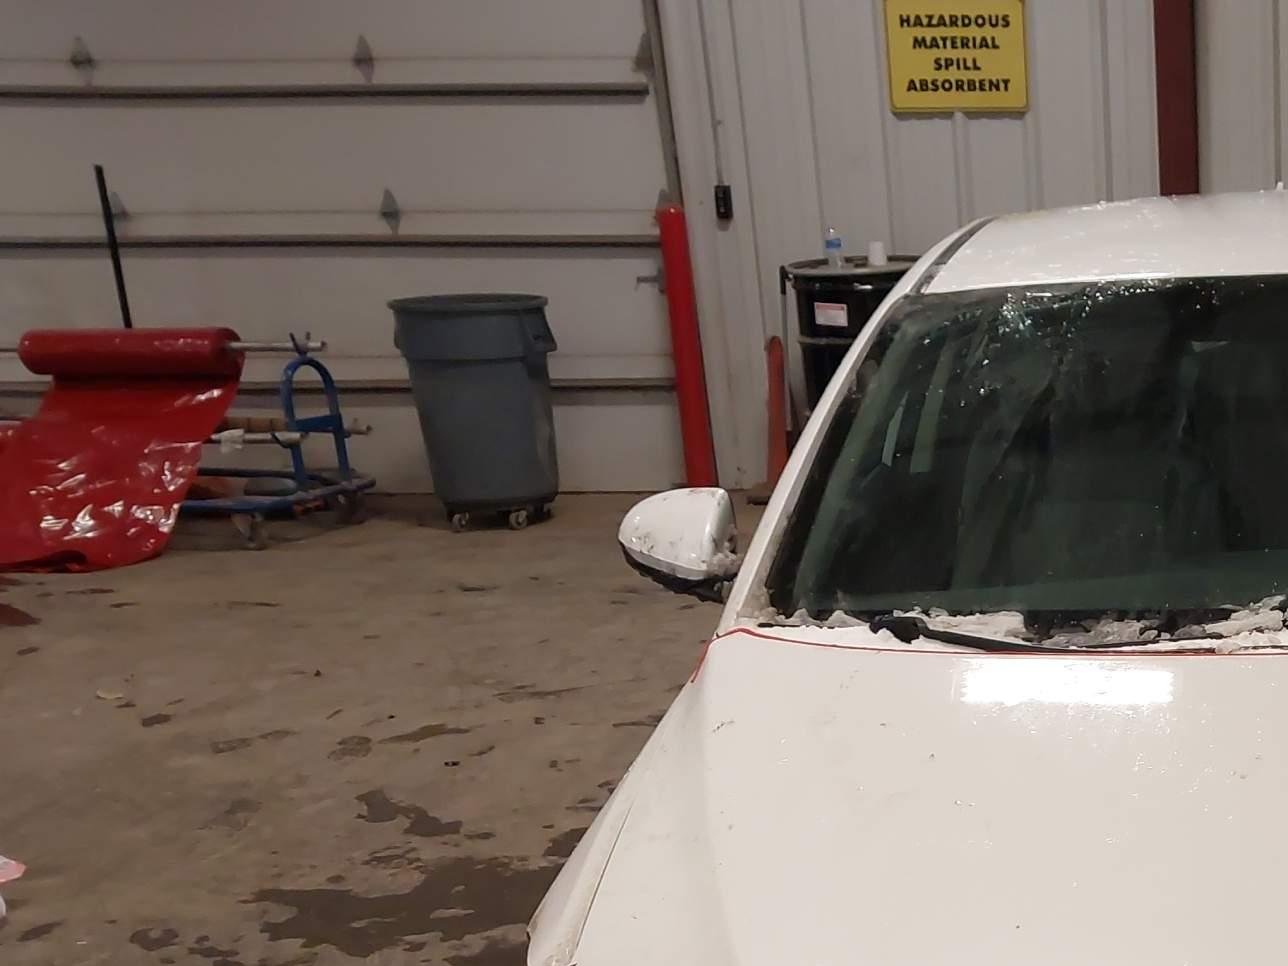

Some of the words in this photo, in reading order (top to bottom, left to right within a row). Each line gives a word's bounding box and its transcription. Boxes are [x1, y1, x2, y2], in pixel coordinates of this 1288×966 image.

[899, 14, 1011, 28] HAZARDOUS
[912, 36, 1000, 49] MATERIAL
[933, 57, 982, 71] SPILL
[906, 79, 1011, 92] ABSORBENT
